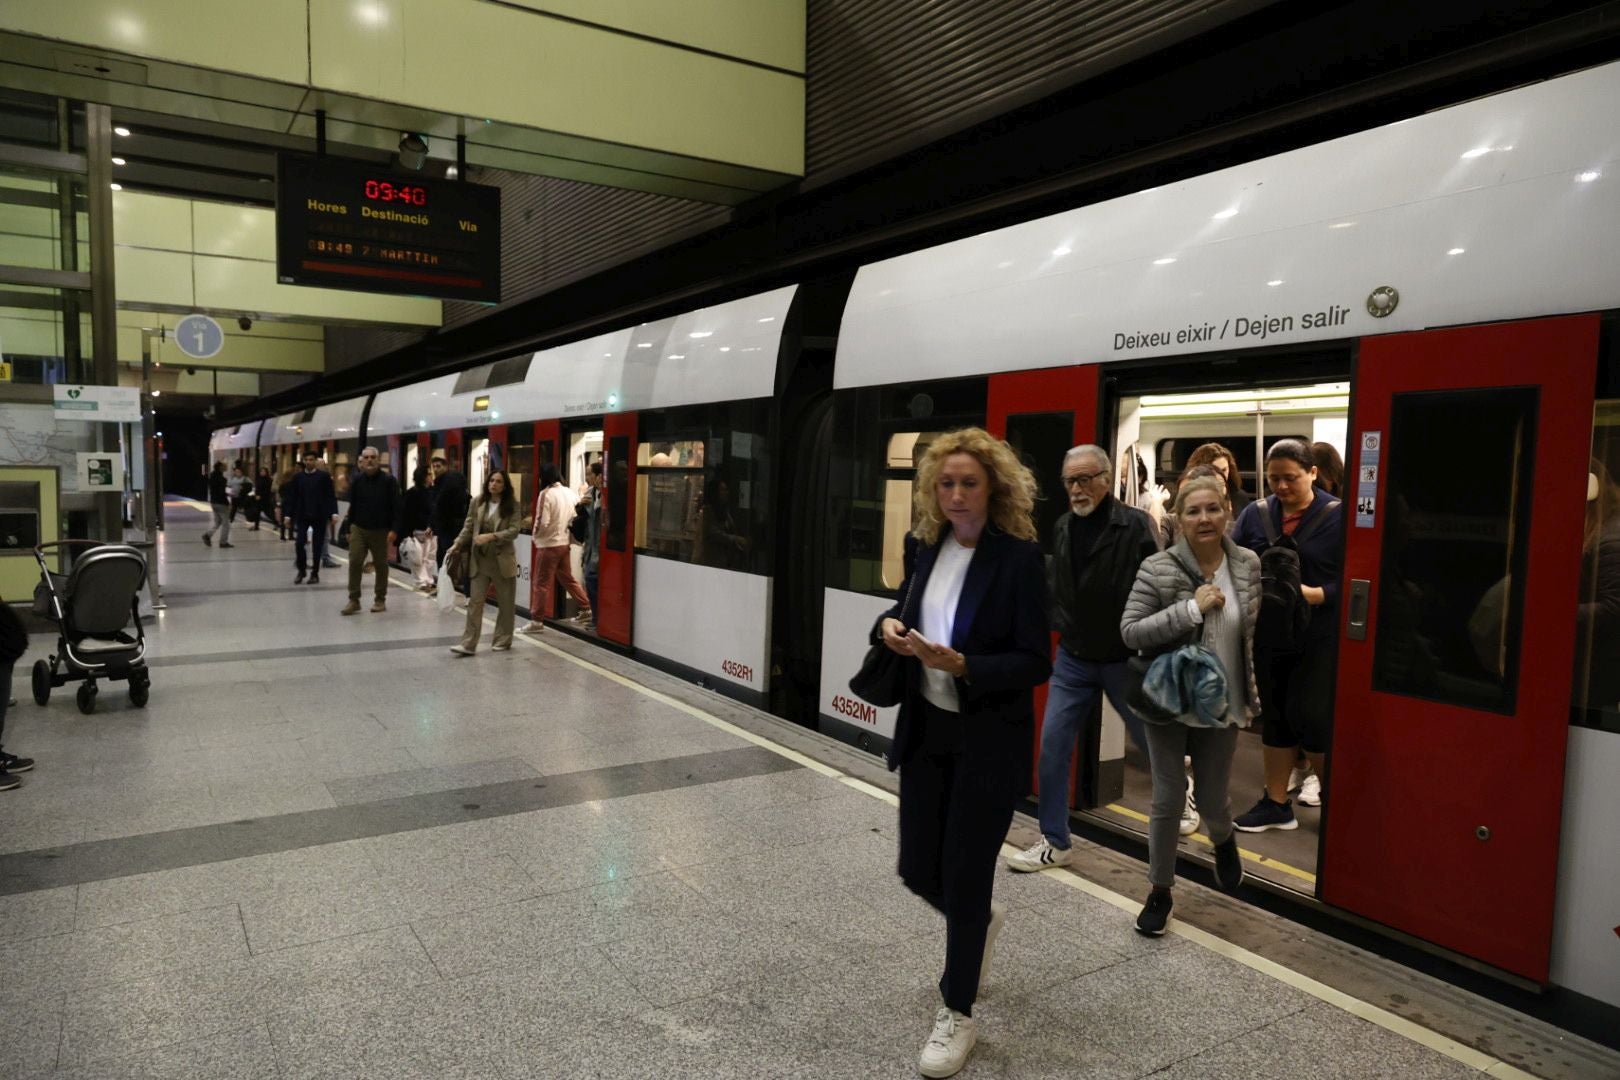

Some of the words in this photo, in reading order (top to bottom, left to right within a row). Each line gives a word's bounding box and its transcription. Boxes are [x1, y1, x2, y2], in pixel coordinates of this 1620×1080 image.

[308, 199, 347, 215] Hores
[361, 206, 429, 225] Destinació
[459, 220, 478, 233] Via
[193, 332, 204, 352] 1
[1113, 331, 1171, 351] Deixeu
[1176, 323, 1217, 345] eixir
[1219, 319, 1230, 340] /
[1234, 314, 1294, 339] Dejen
[1301, 305, 1351, 330] salir
[721, 659, 753, 682] 4352R1
[831, 695, 877, 725] 4352M1
